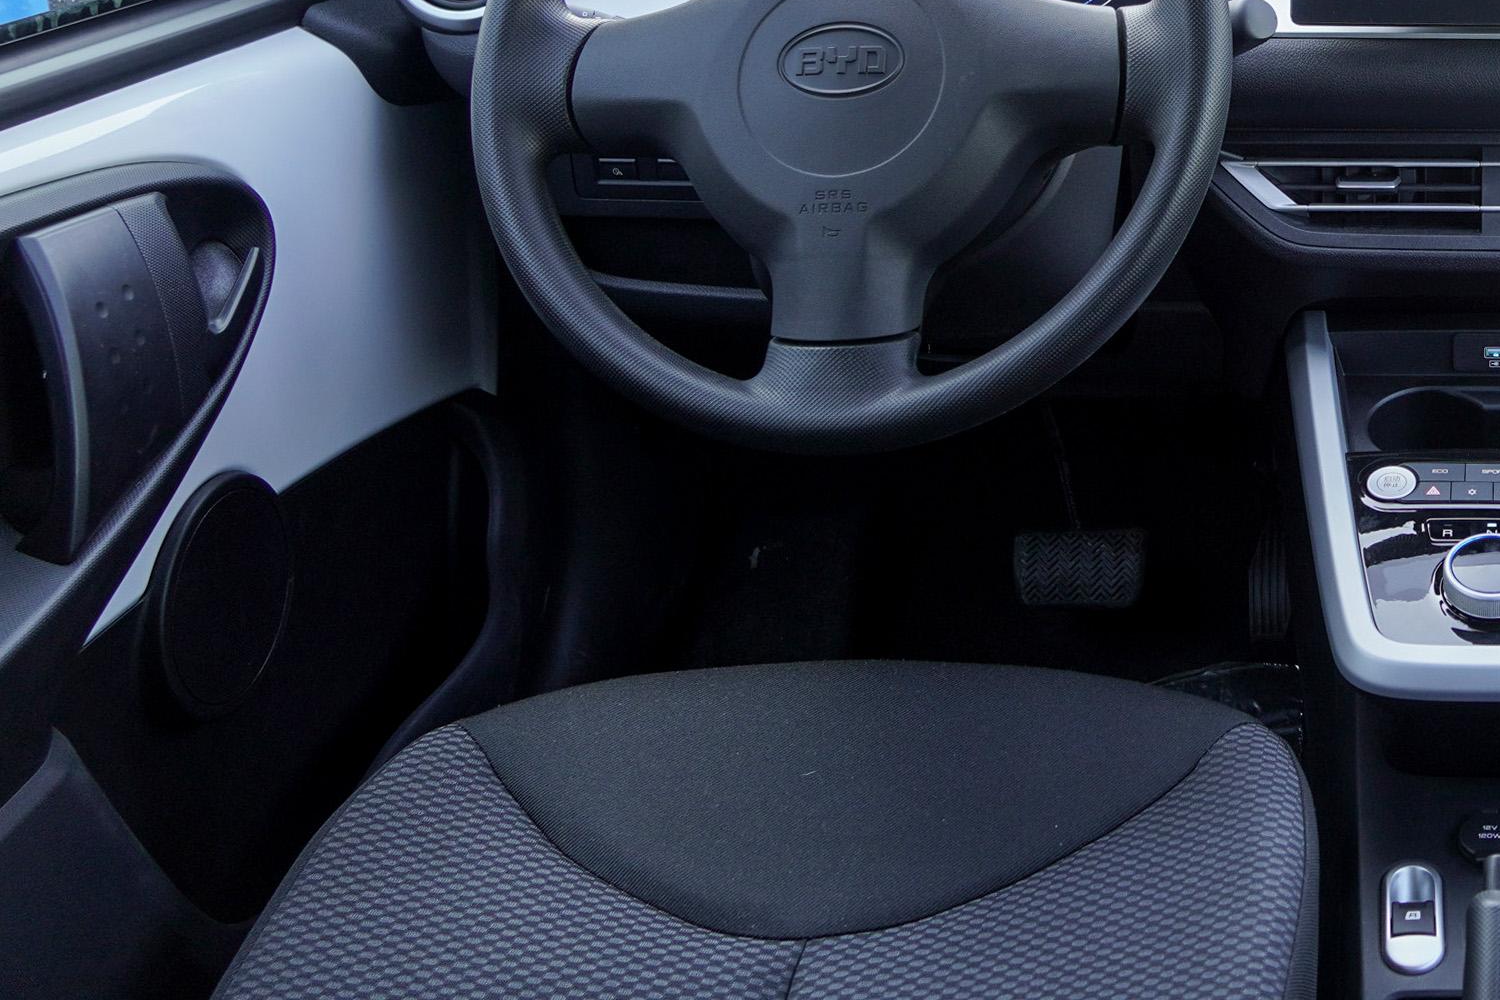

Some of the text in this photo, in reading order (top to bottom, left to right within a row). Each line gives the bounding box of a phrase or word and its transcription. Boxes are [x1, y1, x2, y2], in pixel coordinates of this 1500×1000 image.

[796, 45, 887, 77] BYD
[815, 189, 851, 200] SRS
[799, 202, 869, 215] AIRBAG
[1442, 529, 1453, 537] R
